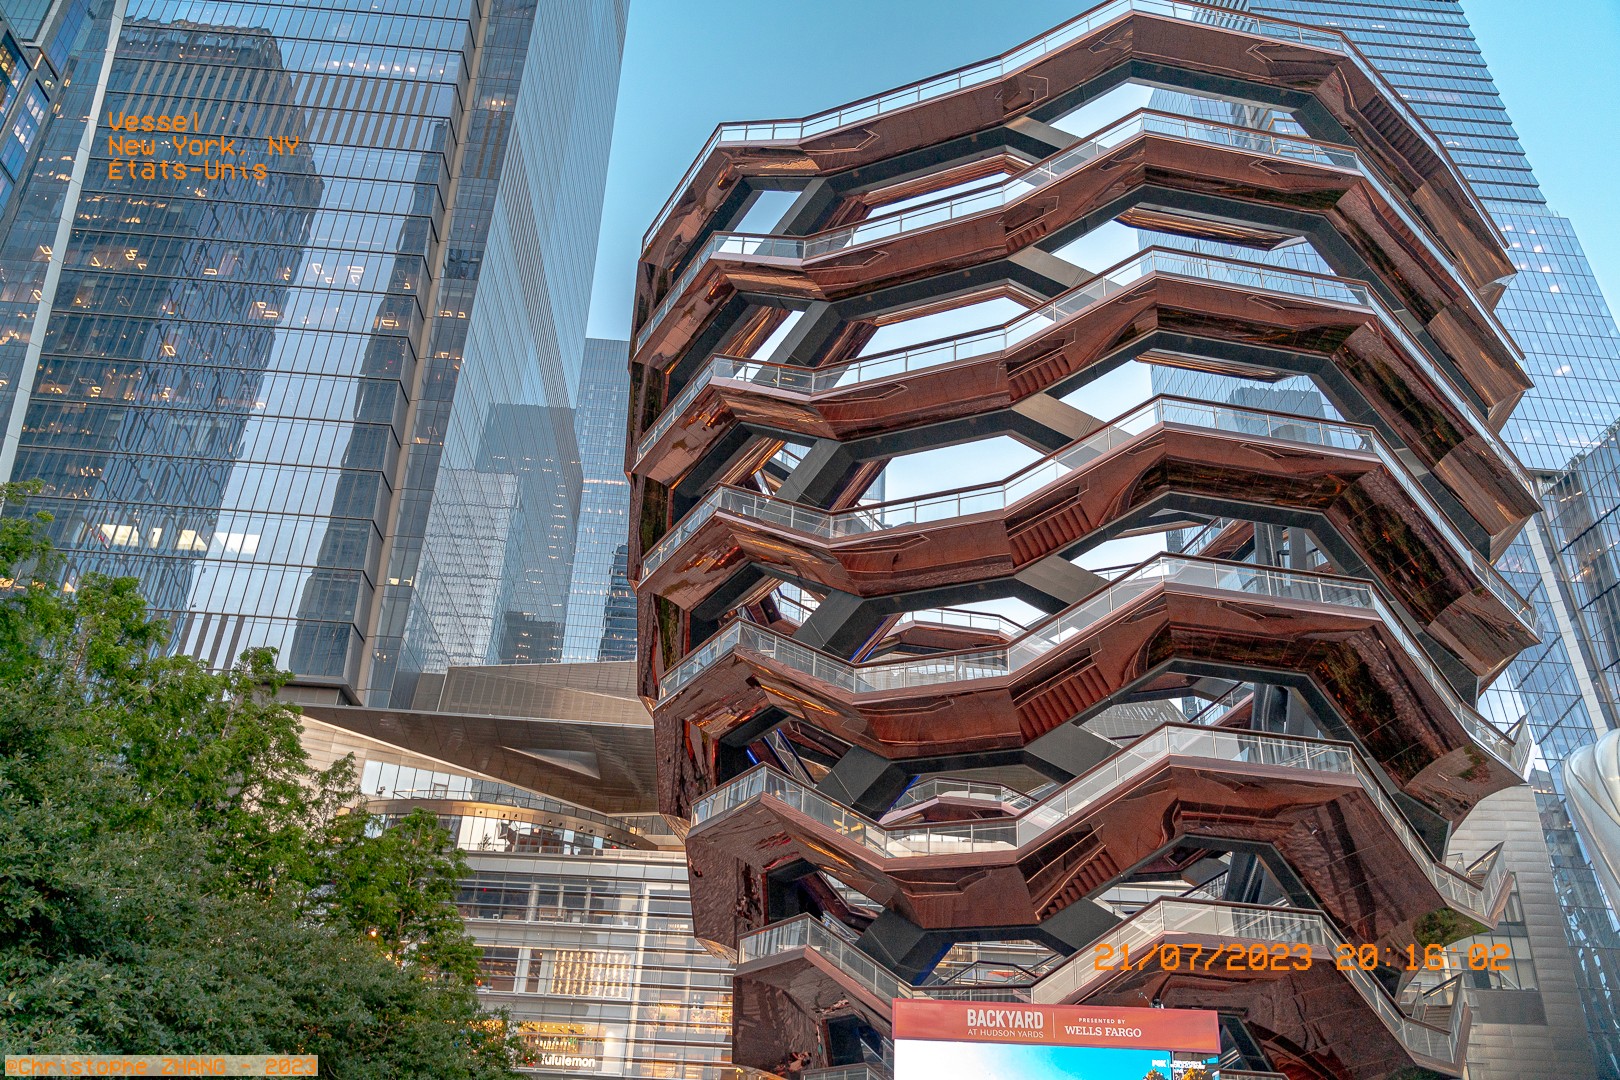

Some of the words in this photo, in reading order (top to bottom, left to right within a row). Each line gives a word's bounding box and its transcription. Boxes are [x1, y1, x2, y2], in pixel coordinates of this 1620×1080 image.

[967, 1008, 1044, 1029] BACKYARD
[967, 1028, 978, 1036] AT
[980, 1029, 1016, 1037] HUDSON
[1017, 1030, 1044, 1038] YARDS
[1064, 1025, 1103, 1036] WELLS
[1105, 1027, 1142, 1038] FARGO
[541, 1053, 596, 1068] lululemon
